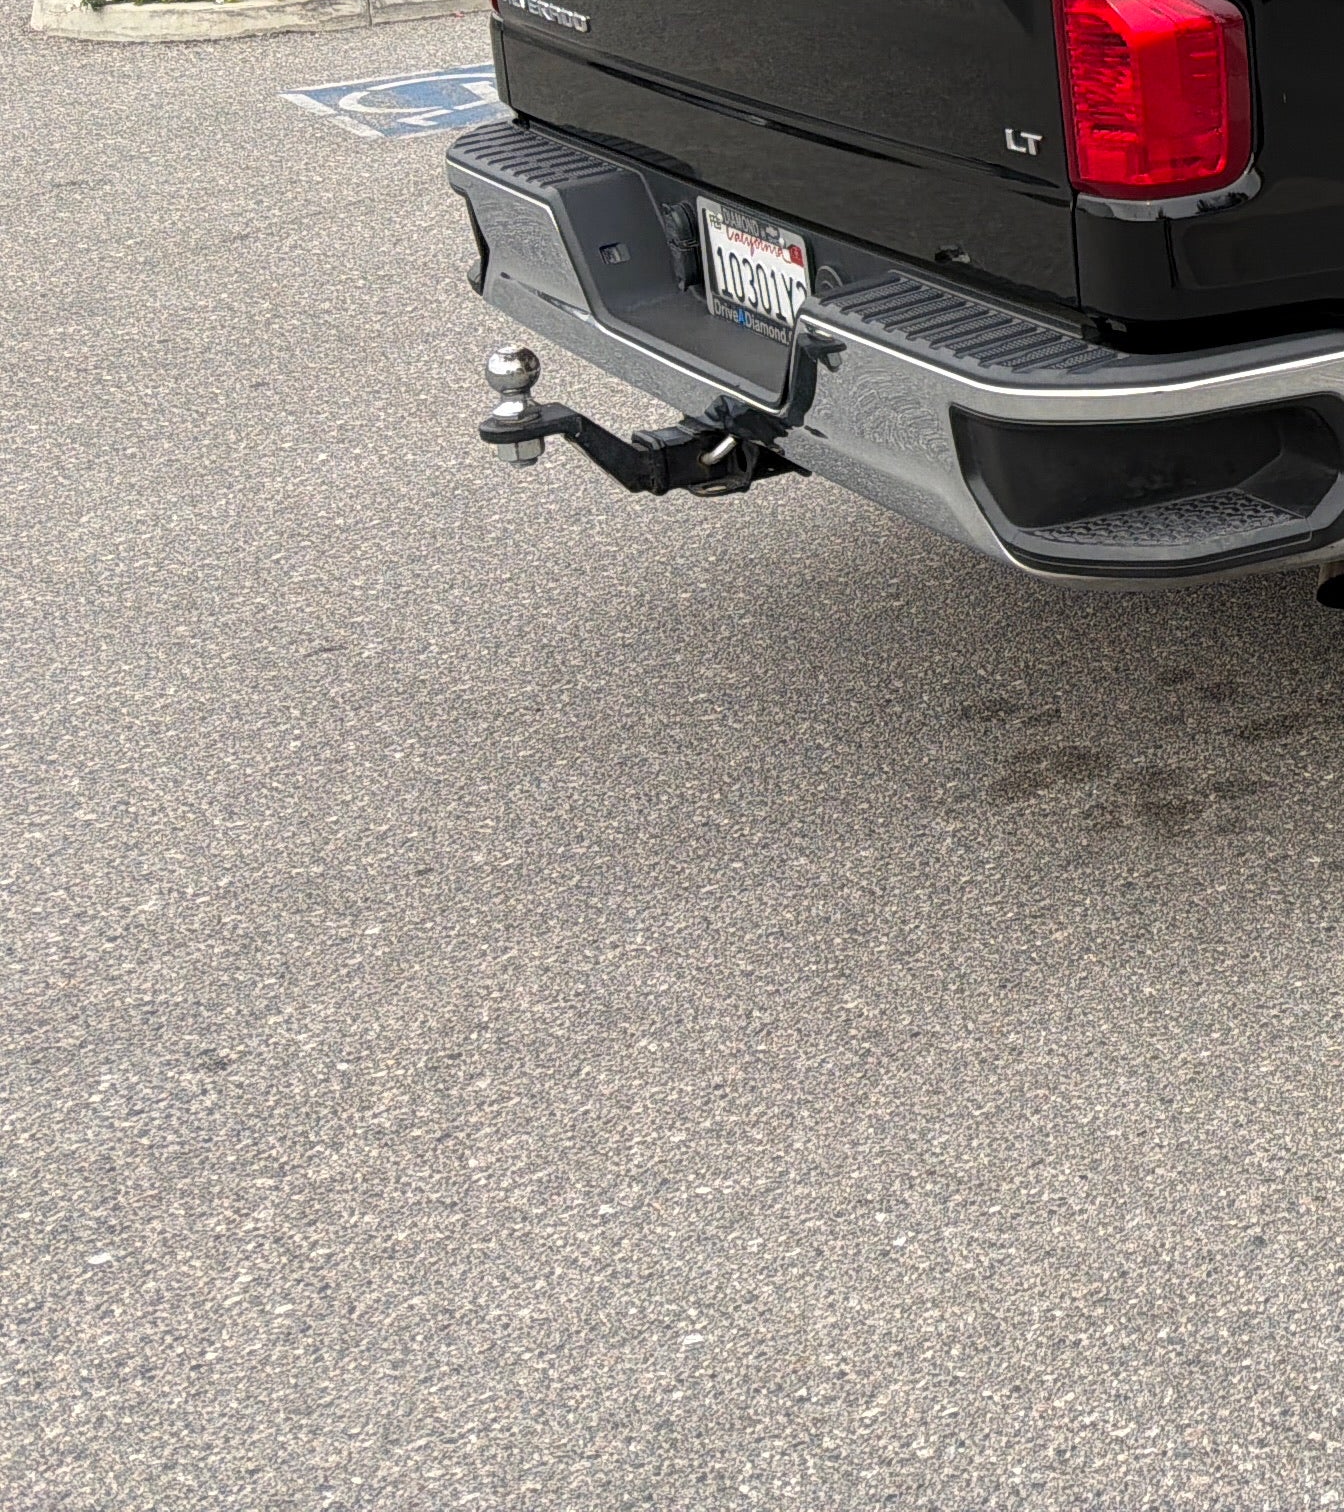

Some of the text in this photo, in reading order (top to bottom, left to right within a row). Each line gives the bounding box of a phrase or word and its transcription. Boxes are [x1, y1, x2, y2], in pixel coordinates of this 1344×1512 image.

[1005, 128, 1043, 156] LT
[722, 207, 760, 236] DIAMOND
[713, 298, 793, 345] DriveADiamond.
